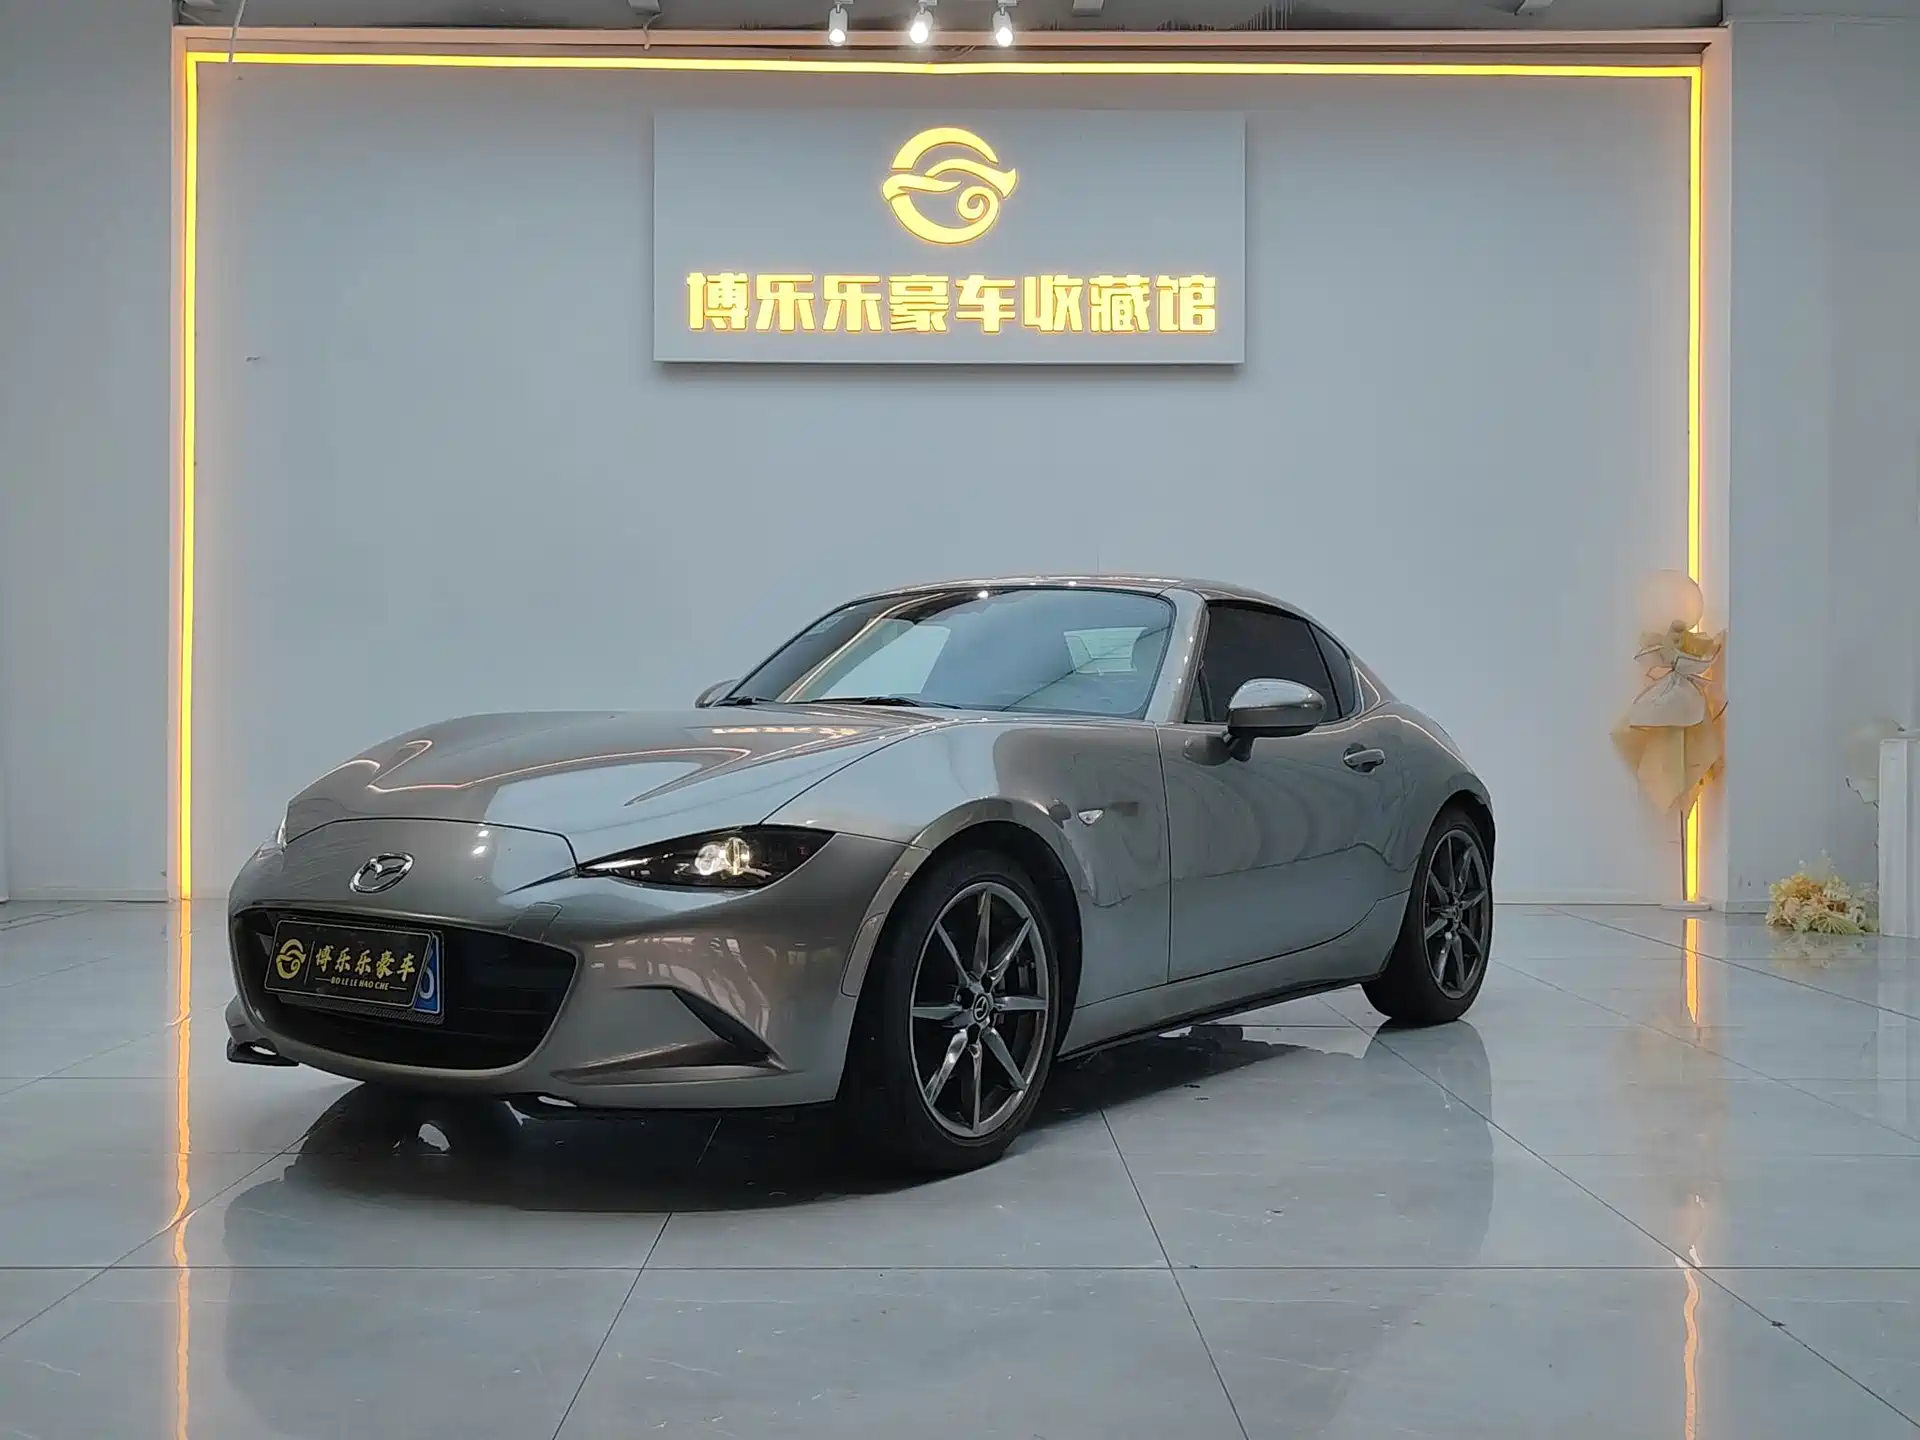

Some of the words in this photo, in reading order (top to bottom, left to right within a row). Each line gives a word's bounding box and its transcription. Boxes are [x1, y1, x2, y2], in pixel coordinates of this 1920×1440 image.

[686, 271, 1217, 333] 博乐乐豪车收藏馆
[315, 945, 416, 982] 博乐乐豪车
[330, 976, 341, 985] BO
[341, 977, 349, 986] LE
[349, 978, 358, 987] LE
[358, 979, 373, 988] HAO
[374, 980, 390, 990] CHE
